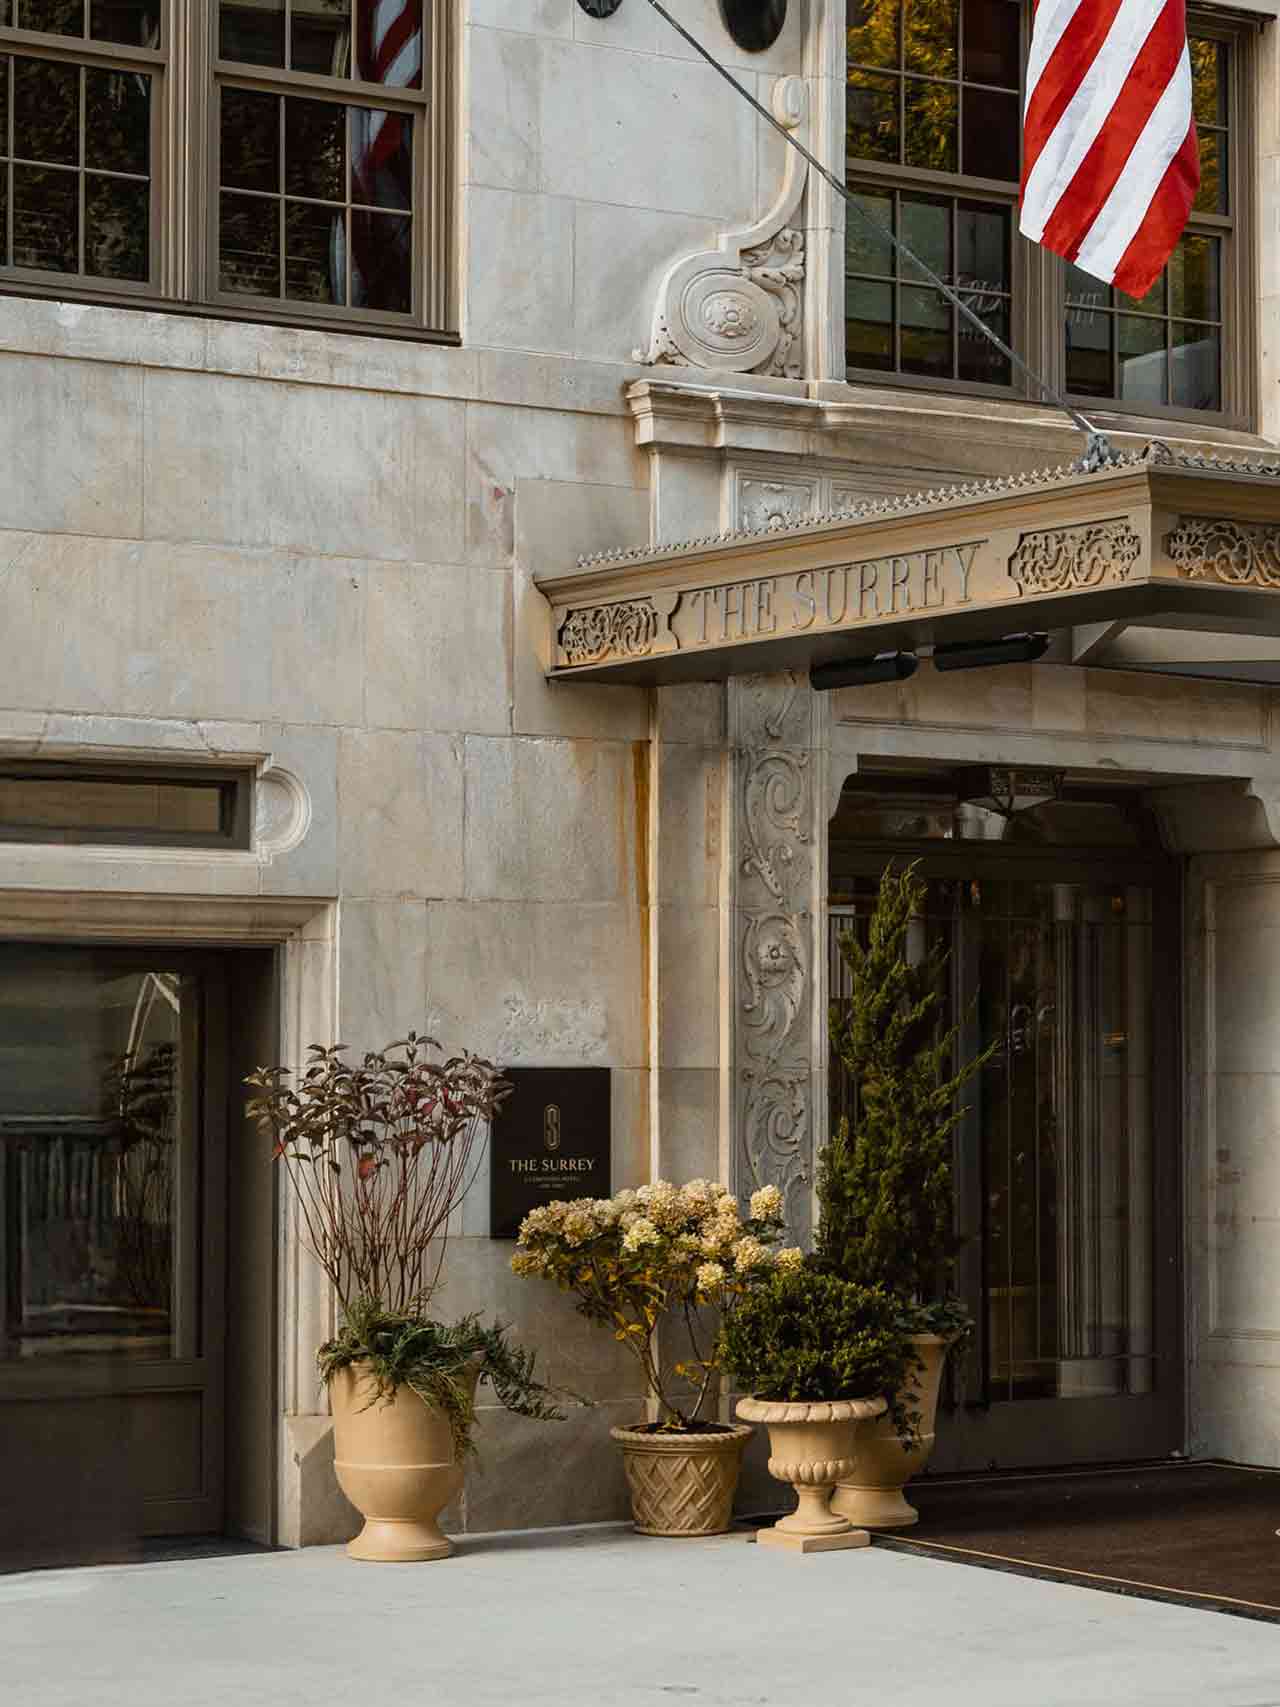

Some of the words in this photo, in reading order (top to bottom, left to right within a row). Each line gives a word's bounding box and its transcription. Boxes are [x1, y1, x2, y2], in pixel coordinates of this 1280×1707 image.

[690, 578, 778, 644] THE
[790, 546, 979, 629] SURREY
[509, 1159, 537, 1172] THE
[541, 1159, 594, 1172] SURREY
